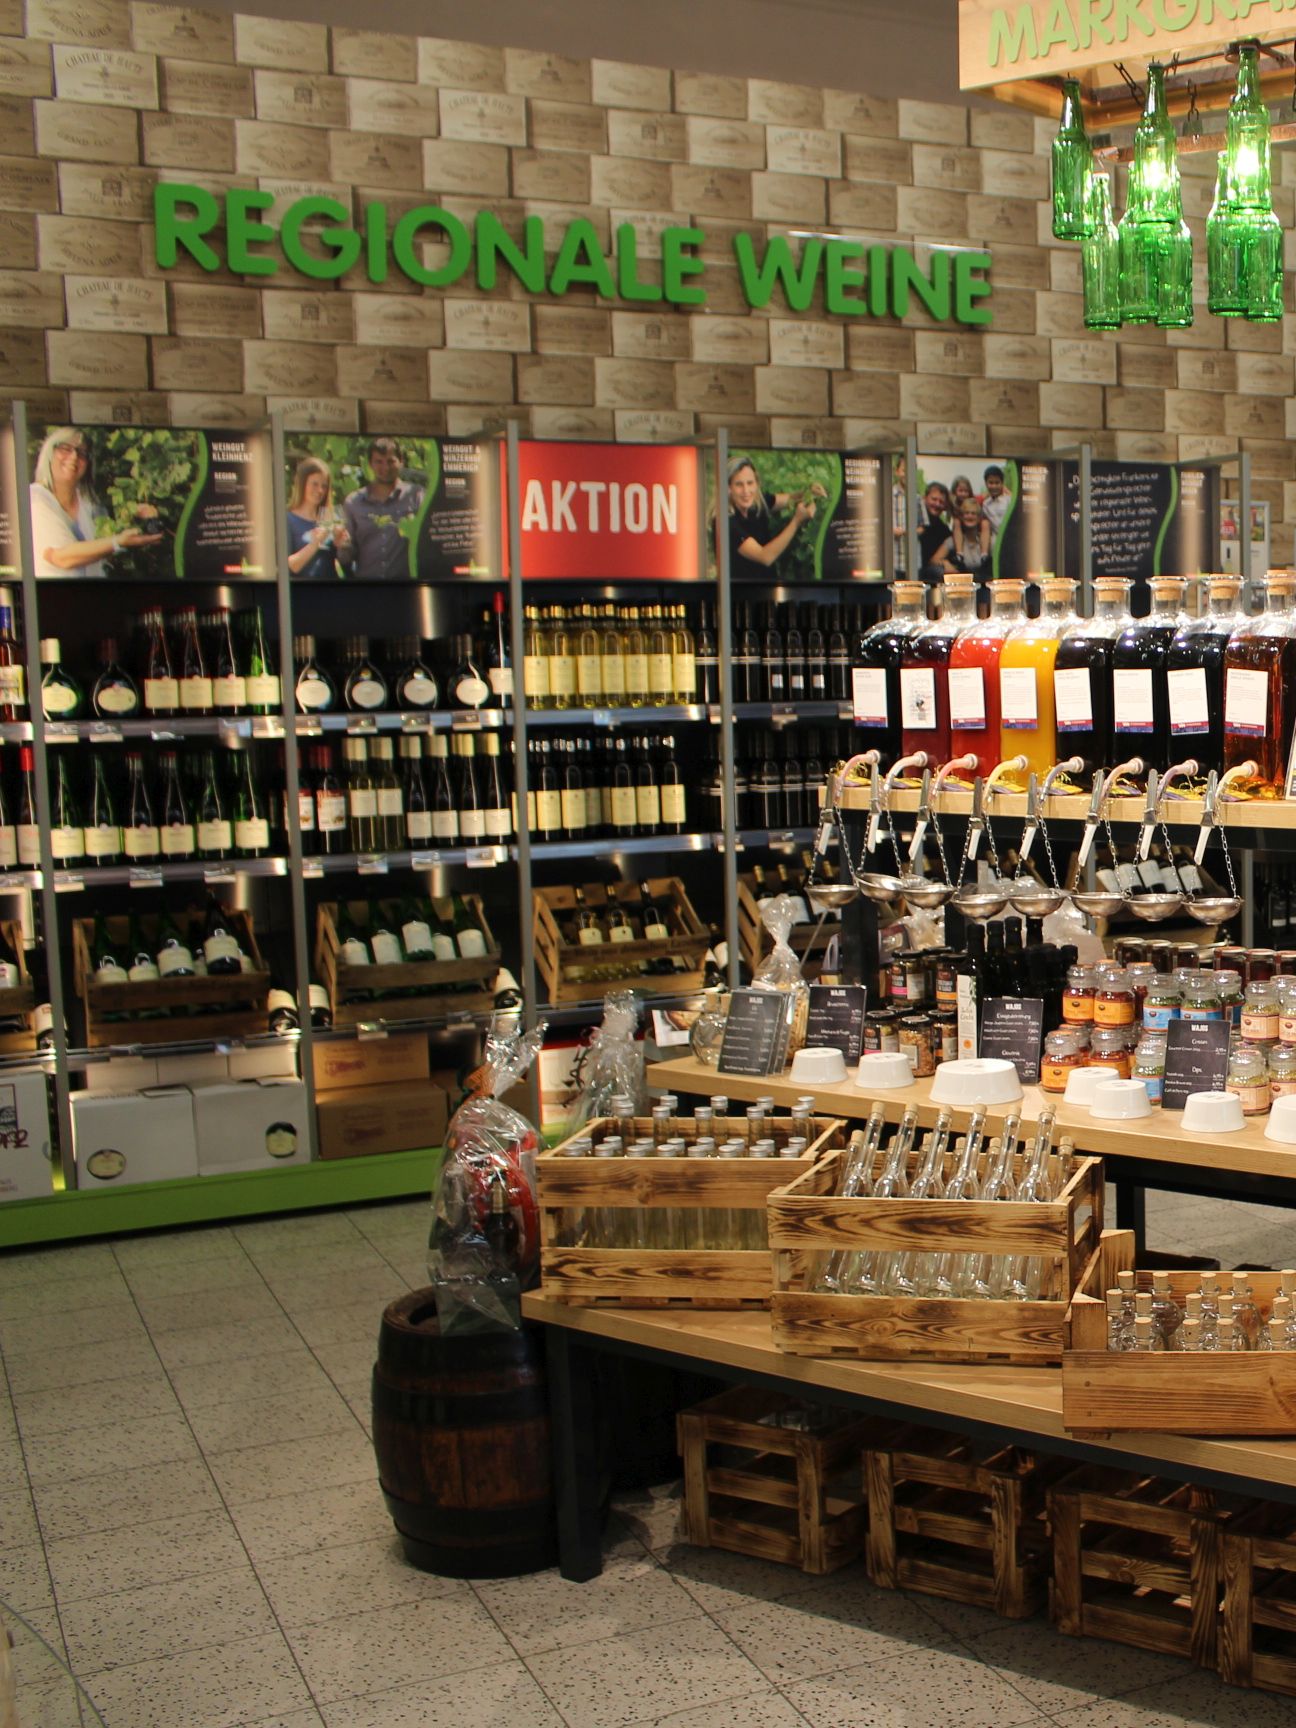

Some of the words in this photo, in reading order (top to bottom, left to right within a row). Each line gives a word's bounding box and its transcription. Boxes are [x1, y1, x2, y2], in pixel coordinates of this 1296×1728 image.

[154, 181, 706, 304] REGIONALE
[734, 231, 994, 325] WEINE
[212, 442, 245, 452] WEINGUT
[521, 479, 678, 535] AKTION
